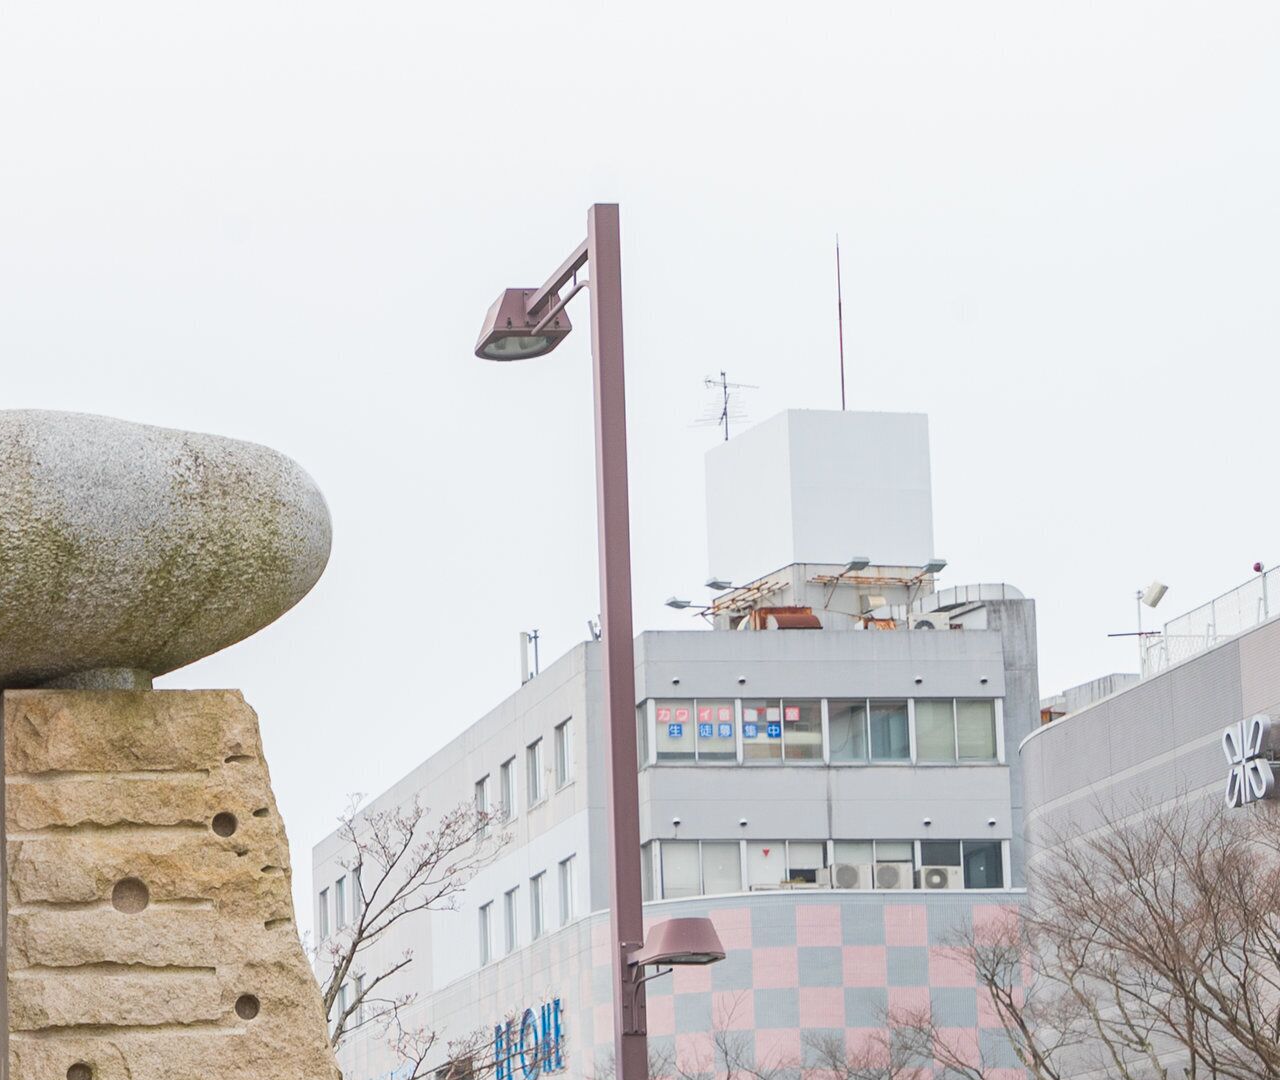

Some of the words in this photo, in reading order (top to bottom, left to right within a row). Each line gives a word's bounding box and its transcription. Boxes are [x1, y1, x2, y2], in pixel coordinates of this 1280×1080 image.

[669, 724, 781, 738] 生徒募集中
